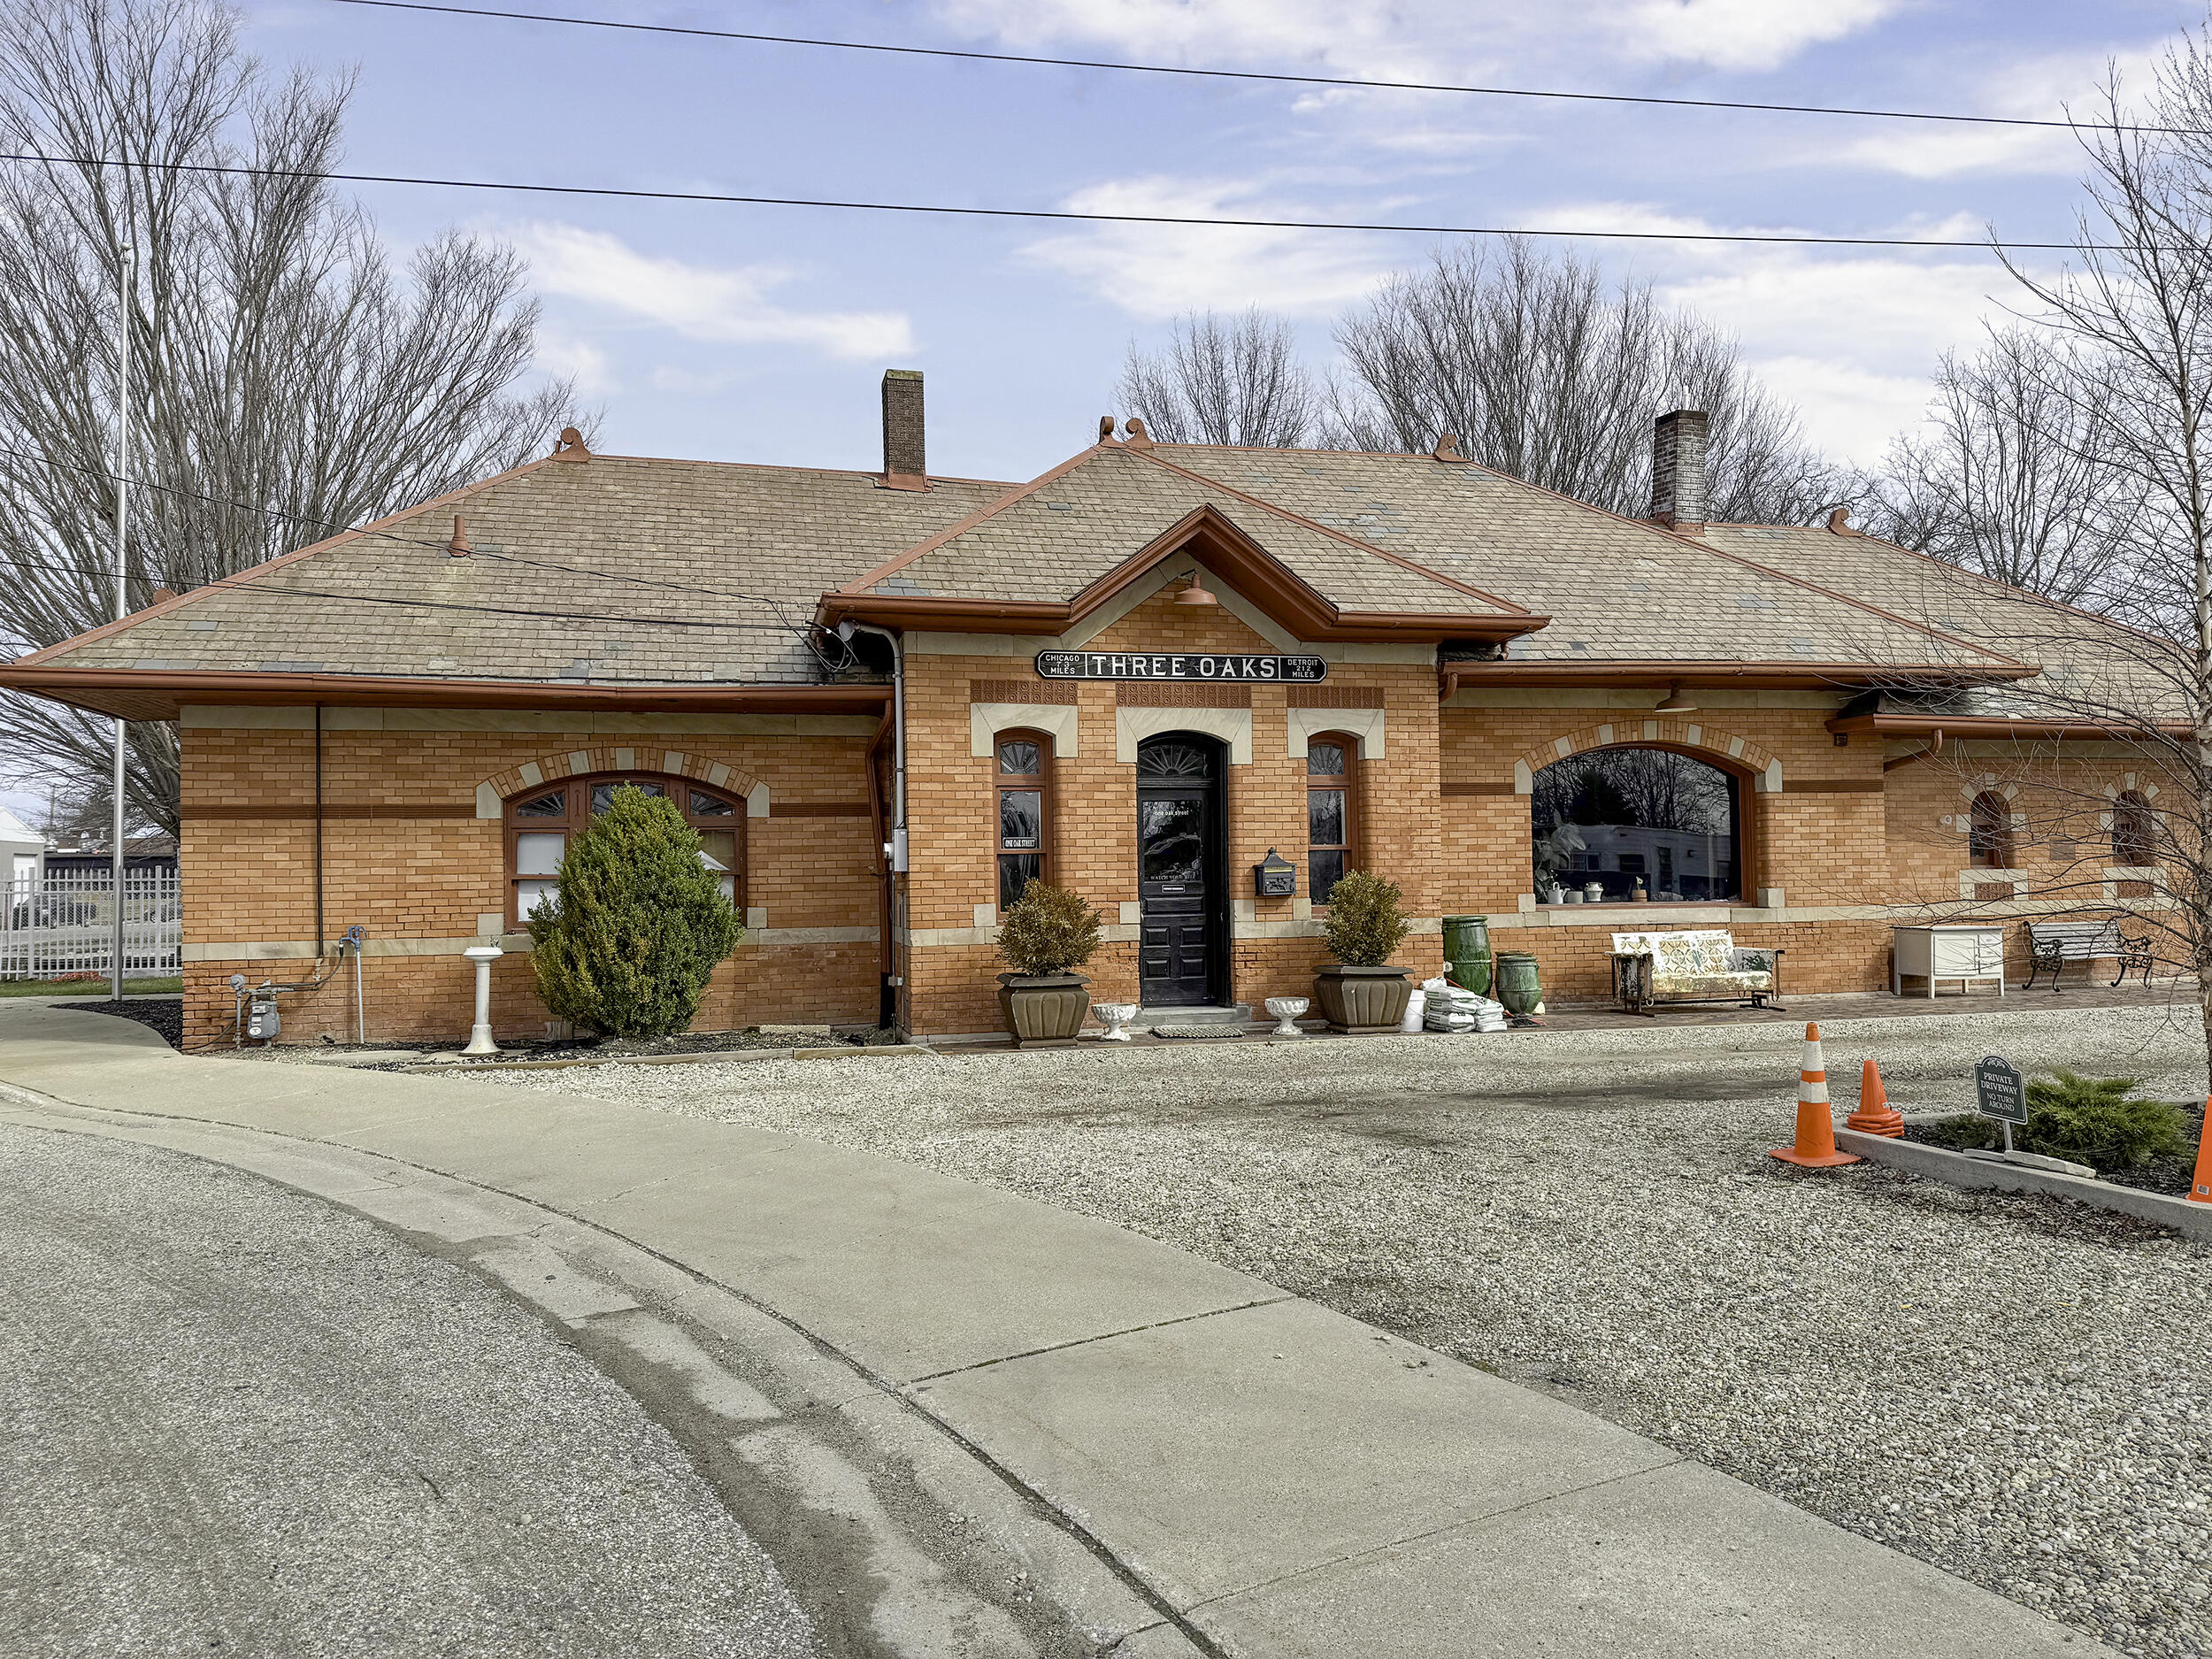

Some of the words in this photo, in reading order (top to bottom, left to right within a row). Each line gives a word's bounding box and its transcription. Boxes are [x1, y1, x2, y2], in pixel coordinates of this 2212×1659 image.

[1091, 656, 1187, 676] THREE
[1199, 657, 1276, 678] OAKS
[1984, 1071, 2013, 1085] PRIVATE
[1981, 1079, 2018, 1095] DRIVEWAY
[1989, 1100, 2015, 1111] AROUND
[1997, 1094, 2015, 1104] TURN
